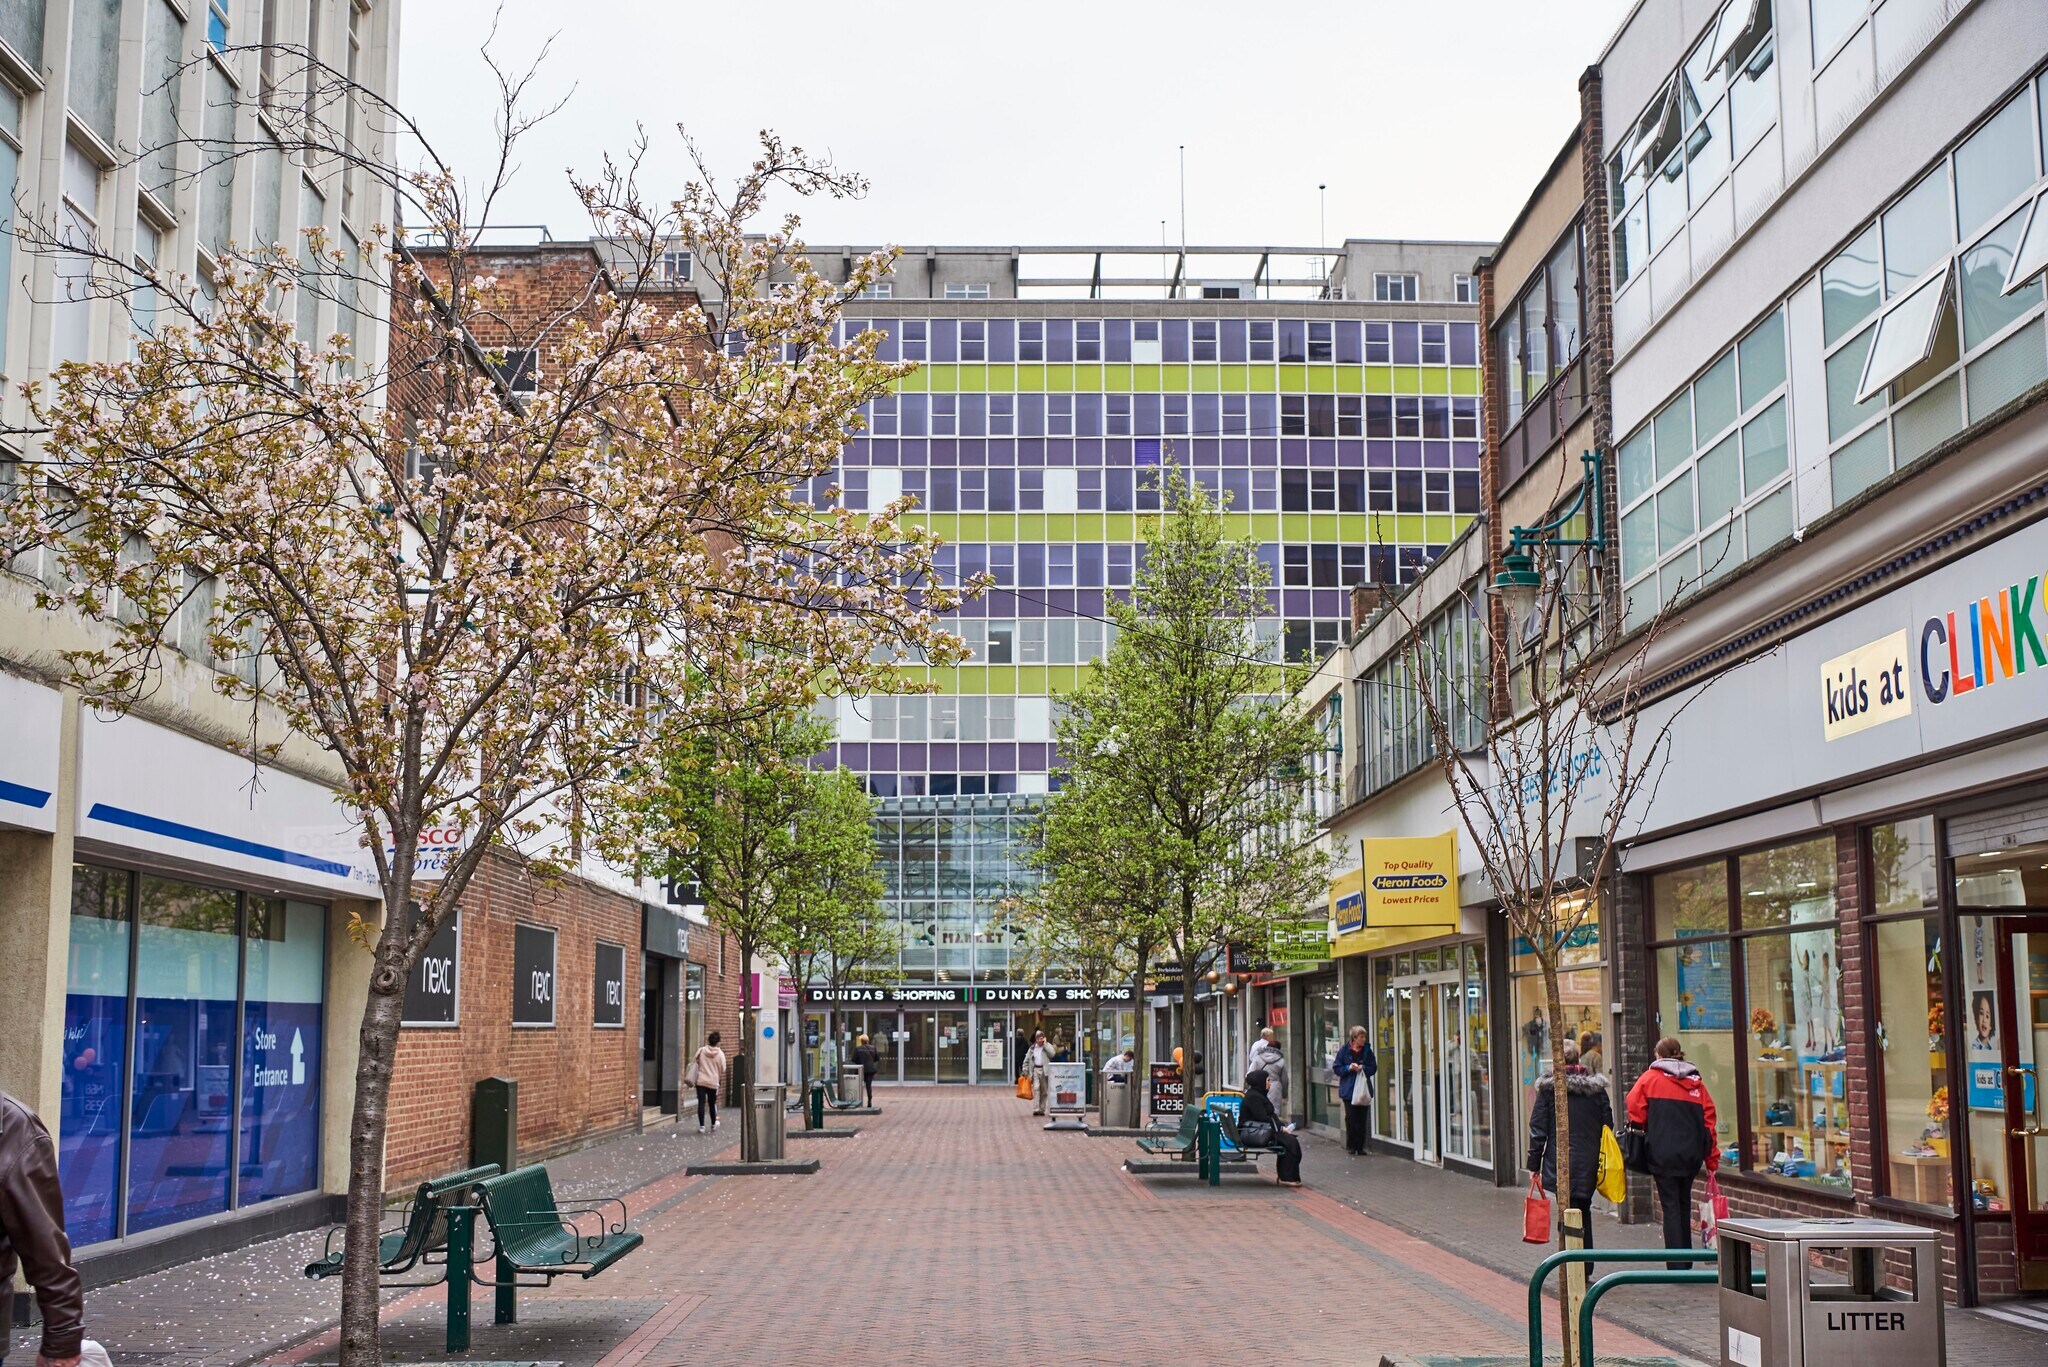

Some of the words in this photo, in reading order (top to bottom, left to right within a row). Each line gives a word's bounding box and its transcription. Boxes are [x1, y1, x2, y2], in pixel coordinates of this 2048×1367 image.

[1826, 667, 1869, 725] kids
[1880, 657, 1905, 706] at
[1920, 575, 2048, 706] CLINK
[387, 829, 461, 845] TSCO
[1384, 861, 1400, 871] Top
[1401, 860, 1434, 870] Quality
[1376, 877, 1410, 888] Heron
[1411, 875, 1444, 887] Foods
[1382, 895, 1412, 904] Lowest
[1413, 895, 1440, 903] Prices
[1337, 903, 1349, 926] Heron
[1349, 896, 1362, 923] Foods
[1274, 930, 1329, 943] CHEF
[1301, 943, 1322, 952] Away
[1284, 952, 1328, 960] Restaurant
[422, 955, 452, 995] next
[531, 969, 551, 1001] next
[606, 978, 621, 1006] next
[813, 990, 884, 1001] DUNDAS
[892, 990, 956, 1001] SHOPPING
[985, 989, 1058, 1000] DUNDAS
[255, 1026, 277, 1051] Store
[254, 1063, 288, 1087] Entrance
[1827, 1312, 1906, 1331] LITTER
